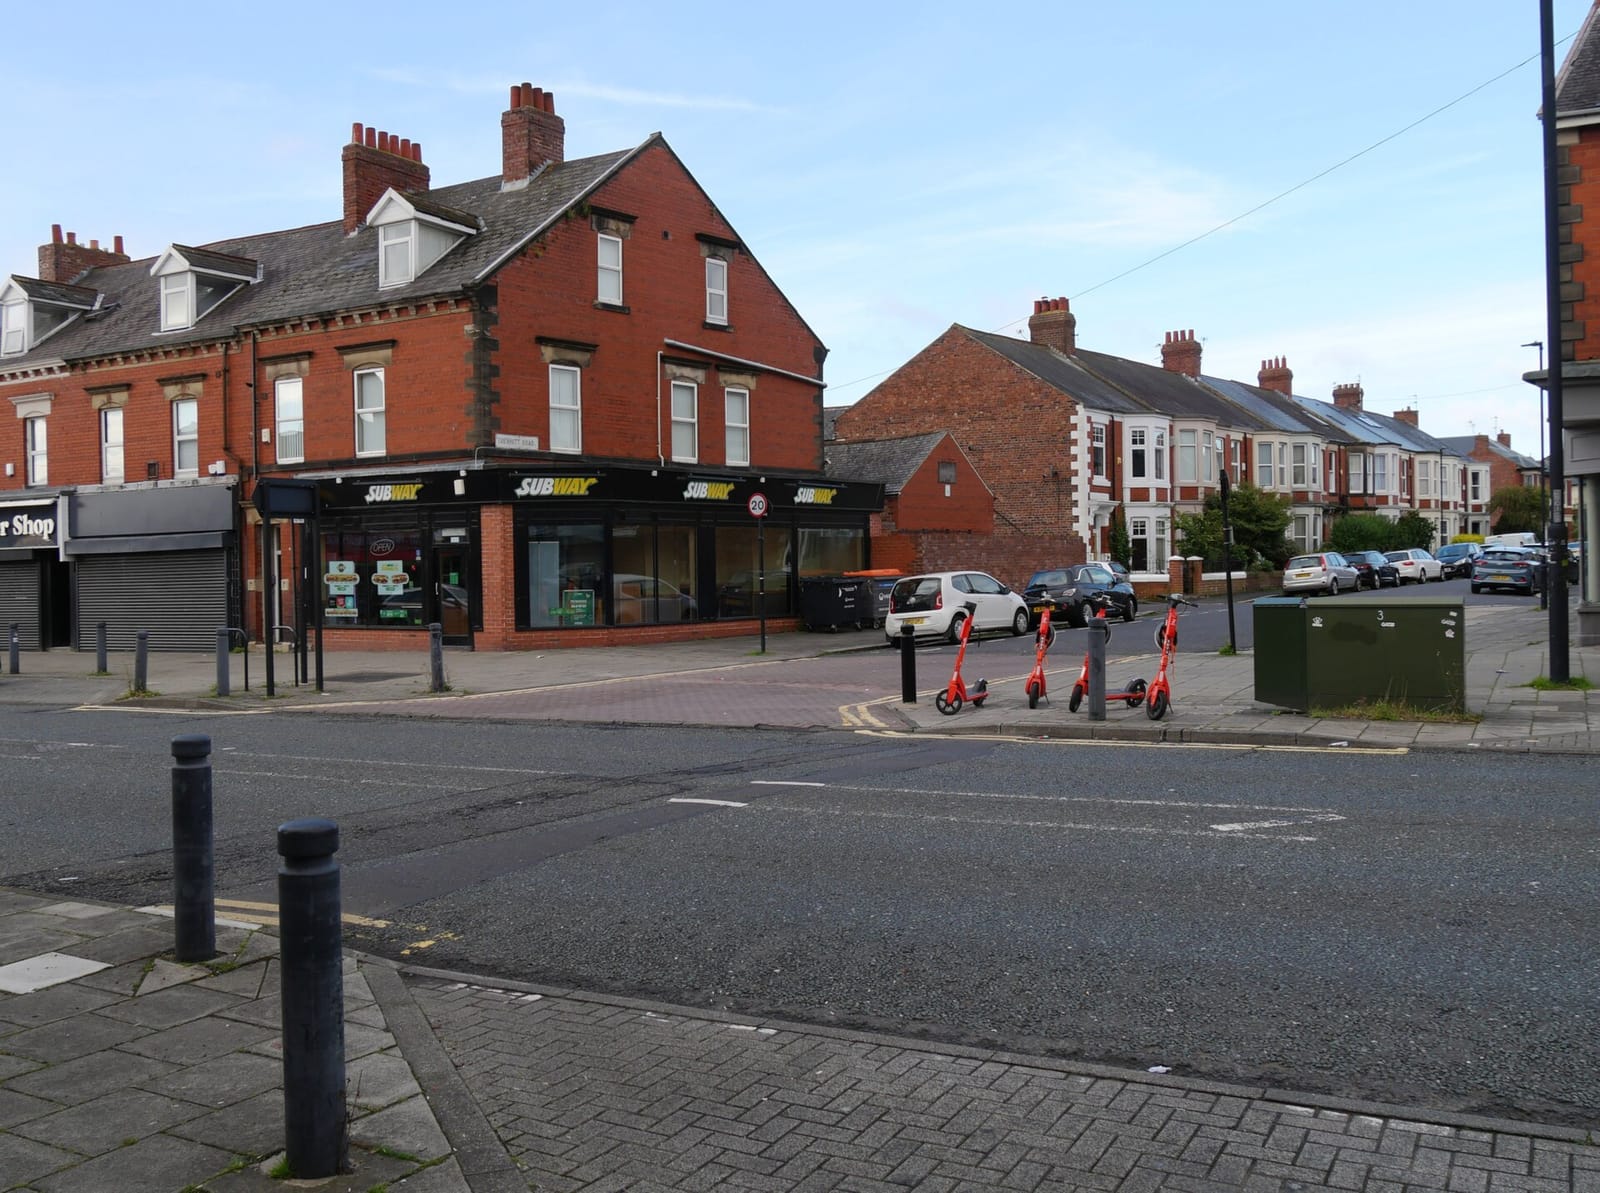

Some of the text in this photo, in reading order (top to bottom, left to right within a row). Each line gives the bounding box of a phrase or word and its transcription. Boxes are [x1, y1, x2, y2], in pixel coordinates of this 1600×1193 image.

[364, 484, 424, 504] SUBWAY
[514, 478, 599, 498] SUBWAY
[683, 482, 735, 501] SUBWAY
[793, 487, 838, 505] SUBWAY
[751, 500, 764, 511] 20
[12, 514, 55, 541] Shop
[373, 543, 391, 553] OPEN
[1376, 610, 1384, 621] 3
